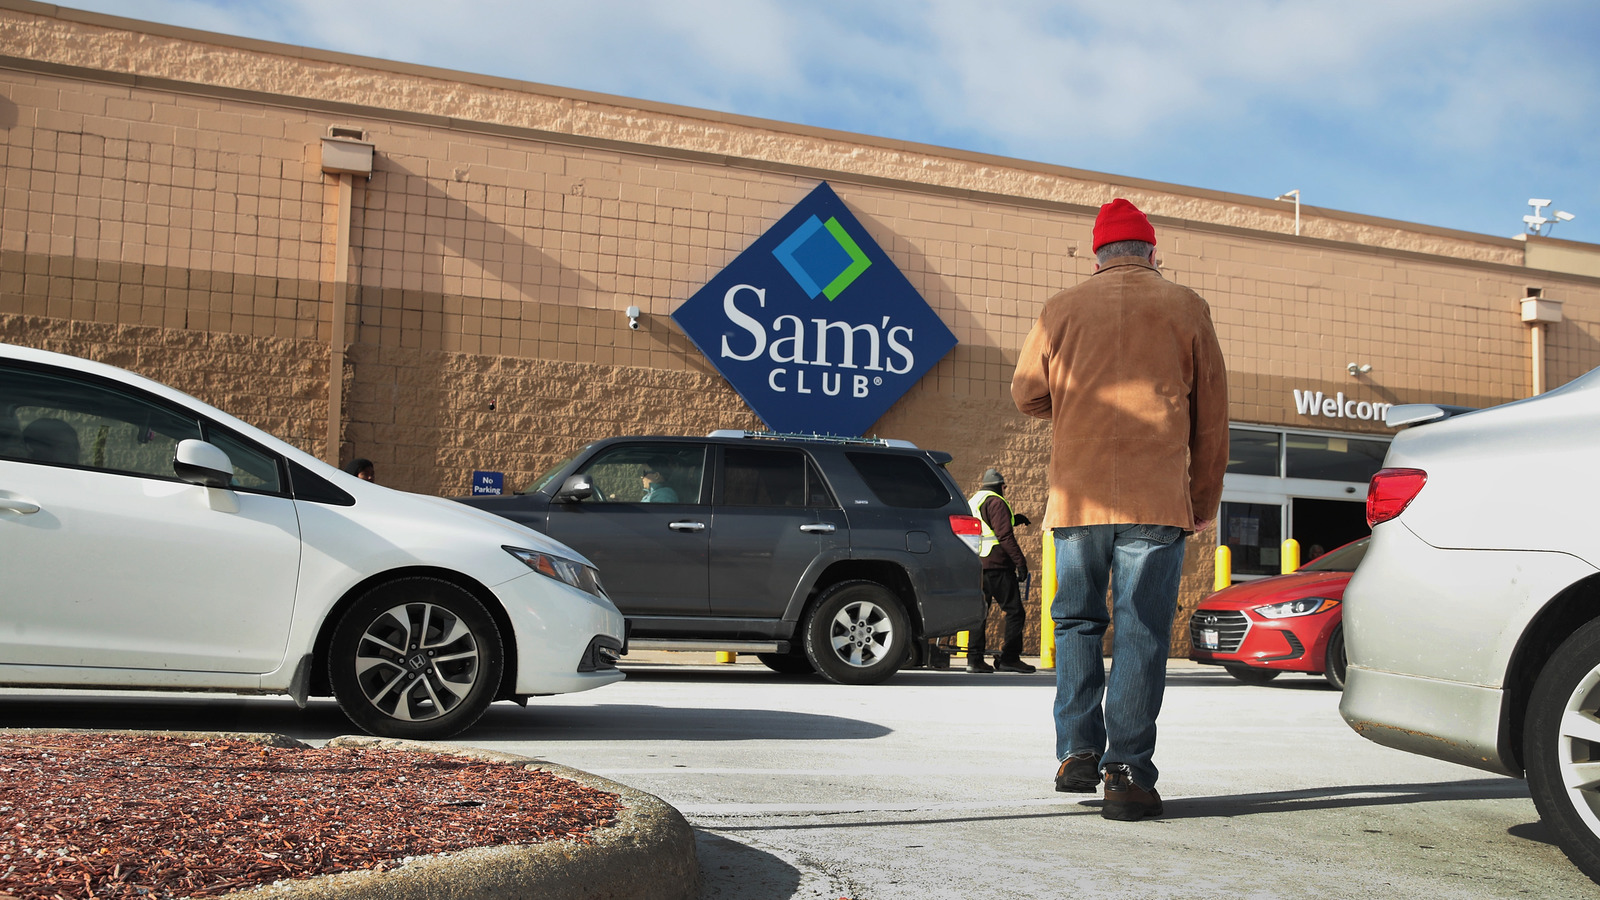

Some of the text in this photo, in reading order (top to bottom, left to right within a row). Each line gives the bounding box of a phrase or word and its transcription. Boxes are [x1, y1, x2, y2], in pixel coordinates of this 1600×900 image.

[721, 284, 914, 374] Sam's
[1293, 390, 1393, 421] Welcom
[474, 485, 501, 495] Parking
[482, 476, 494, 484] No
